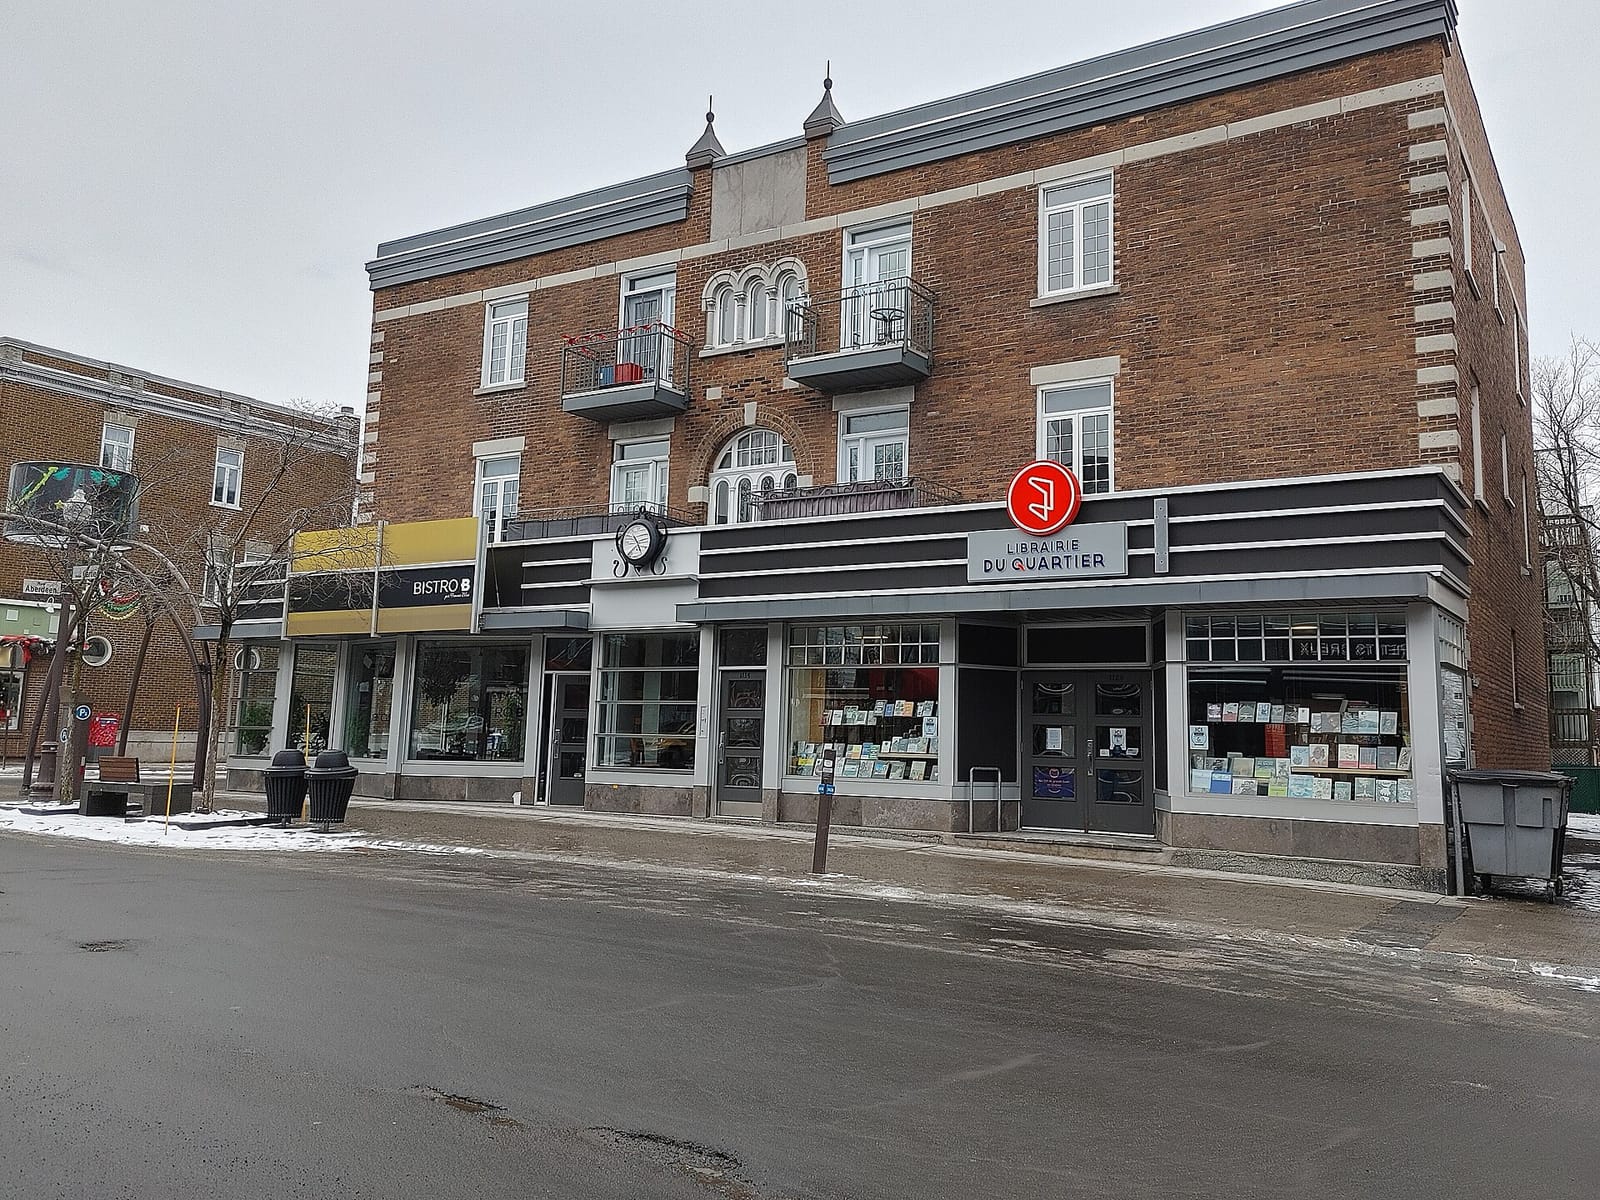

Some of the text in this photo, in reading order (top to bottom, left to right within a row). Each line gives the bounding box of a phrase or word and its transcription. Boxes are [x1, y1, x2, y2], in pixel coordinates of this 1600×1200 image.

[1007, 540, 1080, 554] LIBRAIRIE
[983, 554, 1105, 573] DU QUARTIER
[25, 584, 57, 594] Aberdeen
[413, 578, 470, 595] BISTRO B
